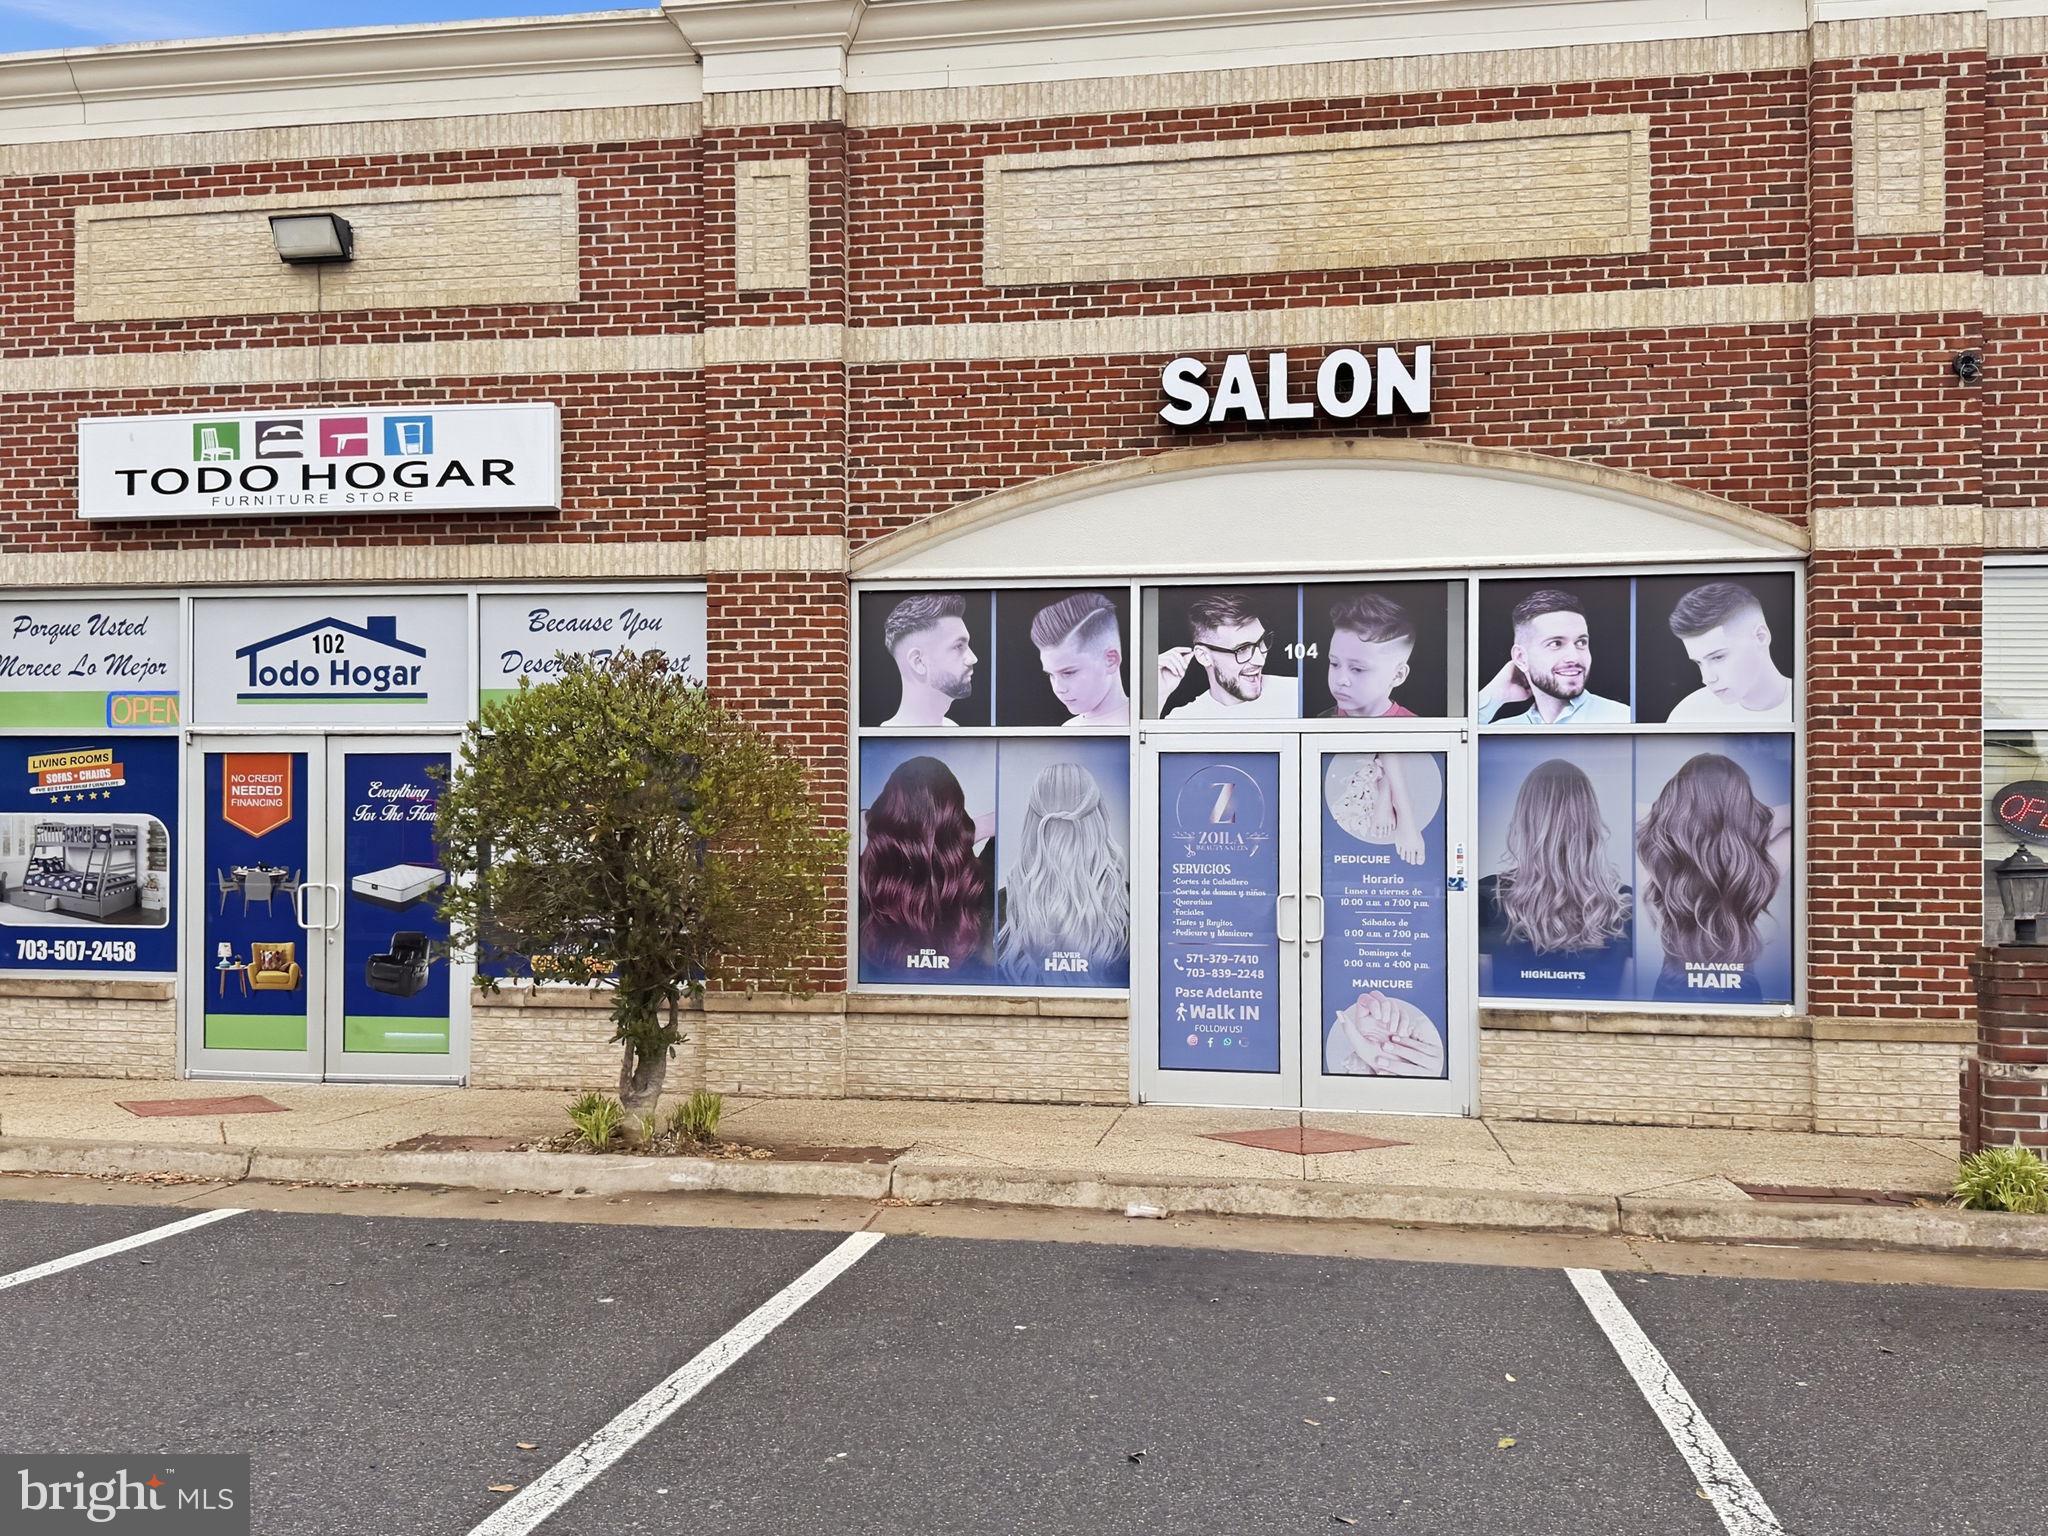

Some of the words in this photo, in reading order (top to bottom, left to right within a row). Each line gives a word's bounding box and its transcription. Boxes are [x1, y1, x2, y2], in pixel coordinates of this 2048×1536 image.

[1159, 345, 1431, 425] SALON
[115, 464, 279, 496] TODO
[303, 459, 516, 490] HOGAR
[212, 493, 329, 507] FURNITURE
[346, 491, 414, 504] STORE
[12, 615, 81, 645] Porque
[87, 613, 149, 637] Usted
[528, 608, 613, 632] Because
[619, 607, 663, 640] You
[312, 634, 345, 654] 102
[1284, 643, 1318, 660] 104
[0, 655, 62, 677] Merece
[67, 653, 97, 677] Lo
[104, 653, 168, 683] Mejor
[501, 650, 581, 674] Deser
[249, 653, 320, 687] Todo
[330, 660, 422, 692] Hogar
[32, 757, 67, 769] LIVING
[70, 753, 109, 765] ROOMS
[45, 771, 73, 784] SOFAS
[79, 768, 112, 781] CHAIRS
[231, 774, 246, 783] NO
[247, 774, 283, 783] CREDIT
[231, 786, 283, 796] NEEDED
[368, 781, 430, 802] Everything
[231, 798, 283, 807] FINANCING
[1210, 782, 1236, 824] Z
[379, 804, 404, 822] The
[406, 804, 441, 822] Hom
[1199, 831, 1245, 845] ZOILA
[1334, 855, 1391, 864] PEDICURE
[1172, 864, 1231, 874] SERVICIOS
[1362, 874, 1404, 884] Horario
[1344, 887, 1368, 895] Lunes
[1412, 888, 1423, 896] de
[1340, 898, 1363, 906] 10:00
[1392, 898, 1411, 907] 7:00
[1398, 918, 1409, 927] de
[1217, 929, 1254, 937] Manicure
[1392, 929, 1411, 938] 7:00
[16, 940, 137, 962] 703-507-2458
[920, 948, 936, 956] RED
[1052, 951, 1081, 959] SILVER
[1358, 948, 1398, 959] Domingos
[1401, 949, 1411, 957] de
[907, 955, 950, 969] HAIR
[1186, 953, 1259, 964] 571-379-7410
[1344, 959, 1363, 967] 9:00
[1392, 960, 1411, 968] 4:00
[1044, 958, 1089, 972] HAIR
[1685, 962, 1744, 972] BALAYAGE
[1185, 968, 1265, 979] 703-839-2248
[1520, 970, 1586, 980] HIGHLIGHTS
[1352, 979, 1413, 989] MANICURE
[1688, 973, 1742, 989] HAIR
[1175, 987, 1203, 998] Pase
[1205, 987, 1263, 999] Adelante
[1189, 1004, 1236, 1019] Walk
[1240, 1005, 1260, 1020] IN
[1194, 1024, 1228, 1033] FOLLOW
[1229, 1025, 1243, 1033] US!
